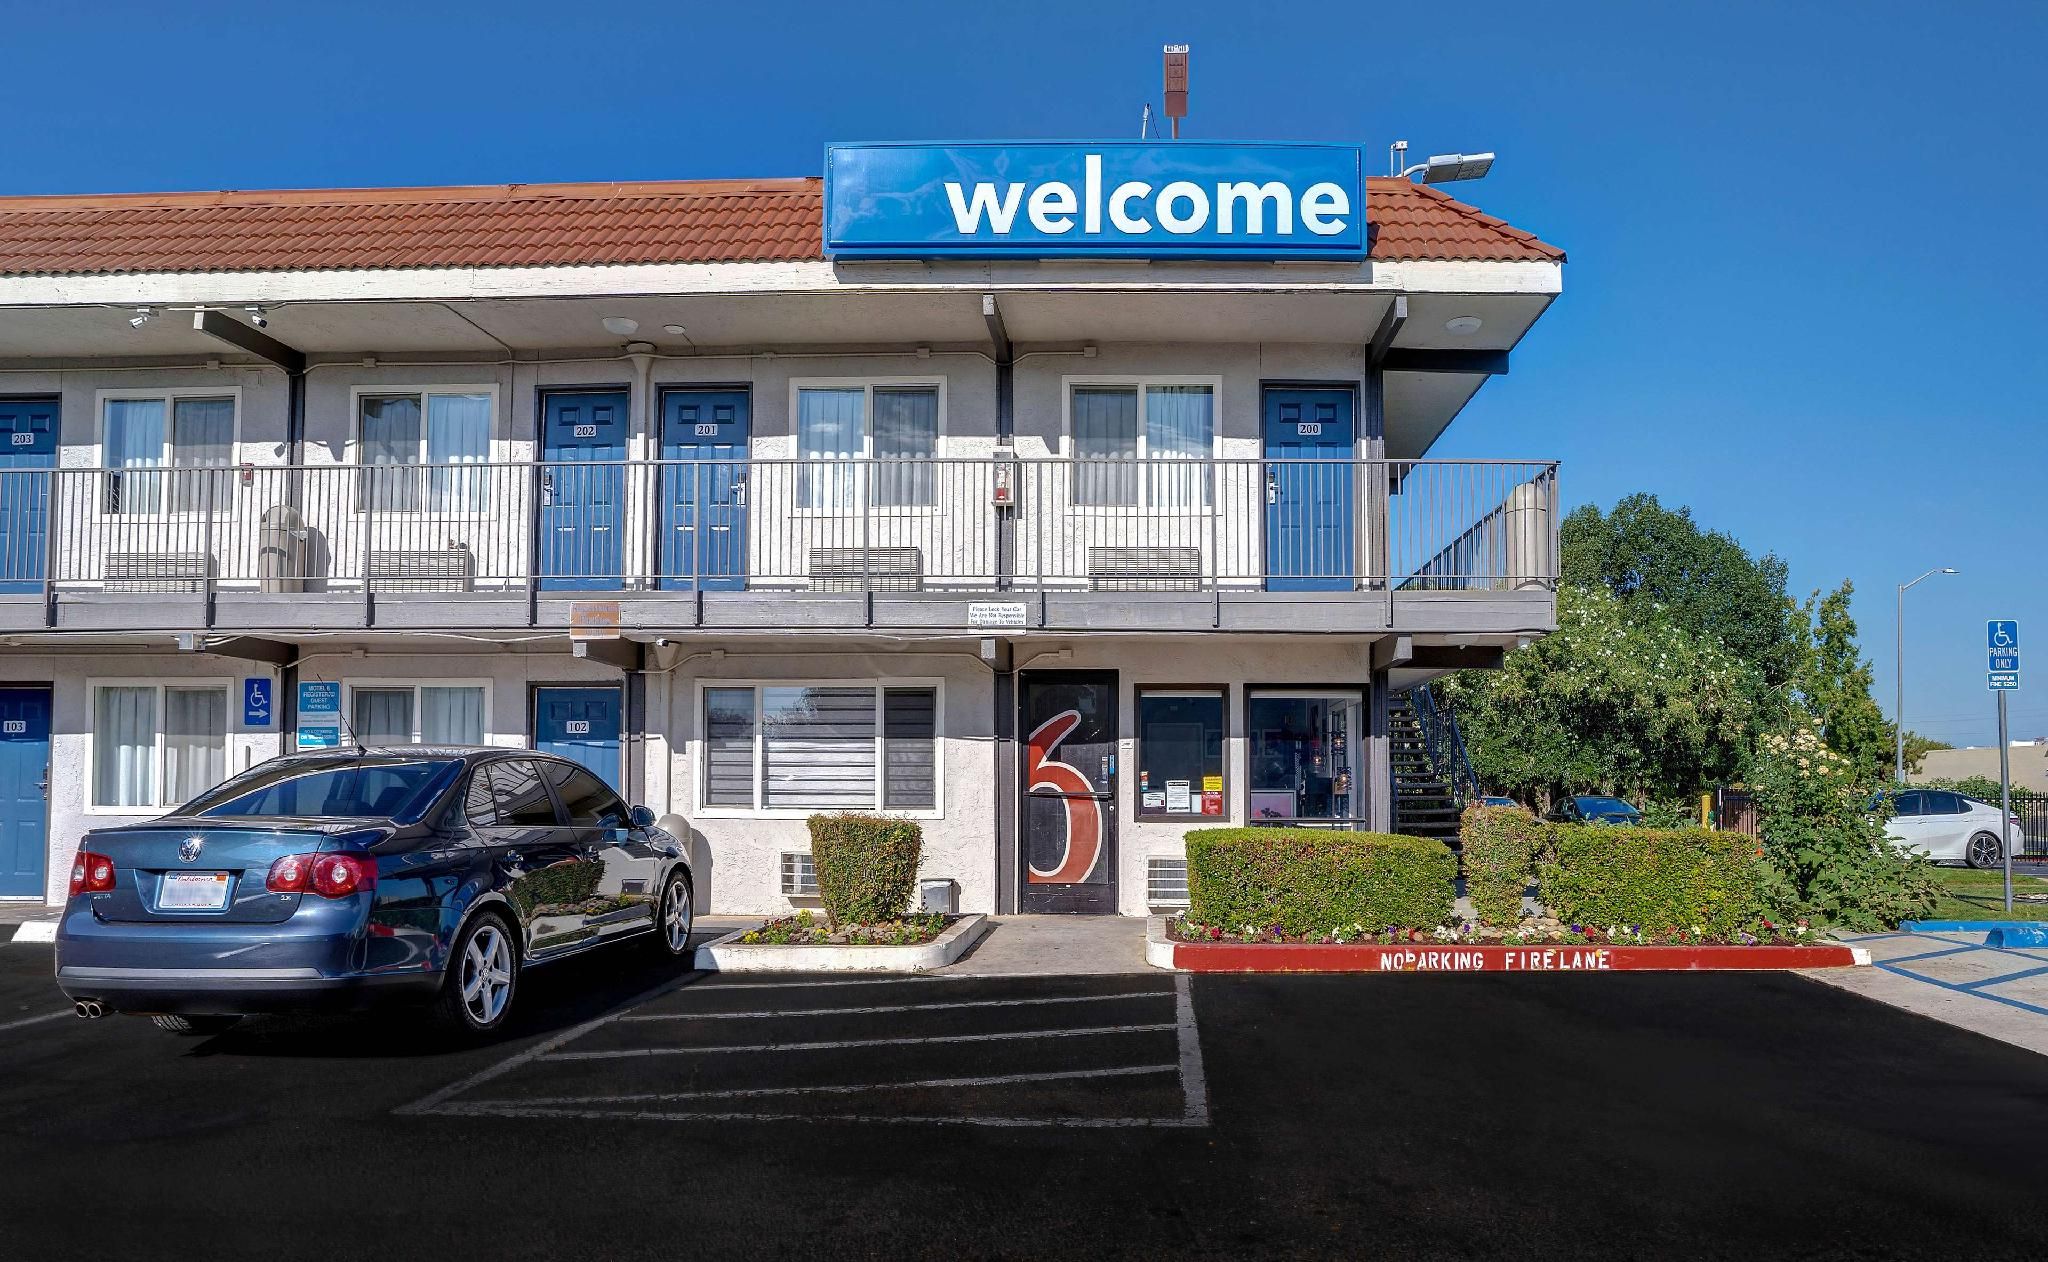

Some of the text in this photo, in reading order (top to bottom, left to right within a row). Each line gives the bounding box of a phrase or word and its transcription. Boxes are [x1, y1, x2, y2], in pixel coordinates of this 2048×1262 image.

[943, 154, 1350, 235] welcome
[576, 426, 595, 436] 202
[698, 425, 716, 435] 201
[1300, 424, 1319, 434] 200
[14, 434, 31, 444] 203
[1989, 647, 2018, 657] PARKING
[1995, 658, 2012, 669] ONLY
[6, 722, 23, 732] 103
[570, 722, 587, 732] 102
[1380, 949, 1611, 971] NO PARKING FIRE LANE
